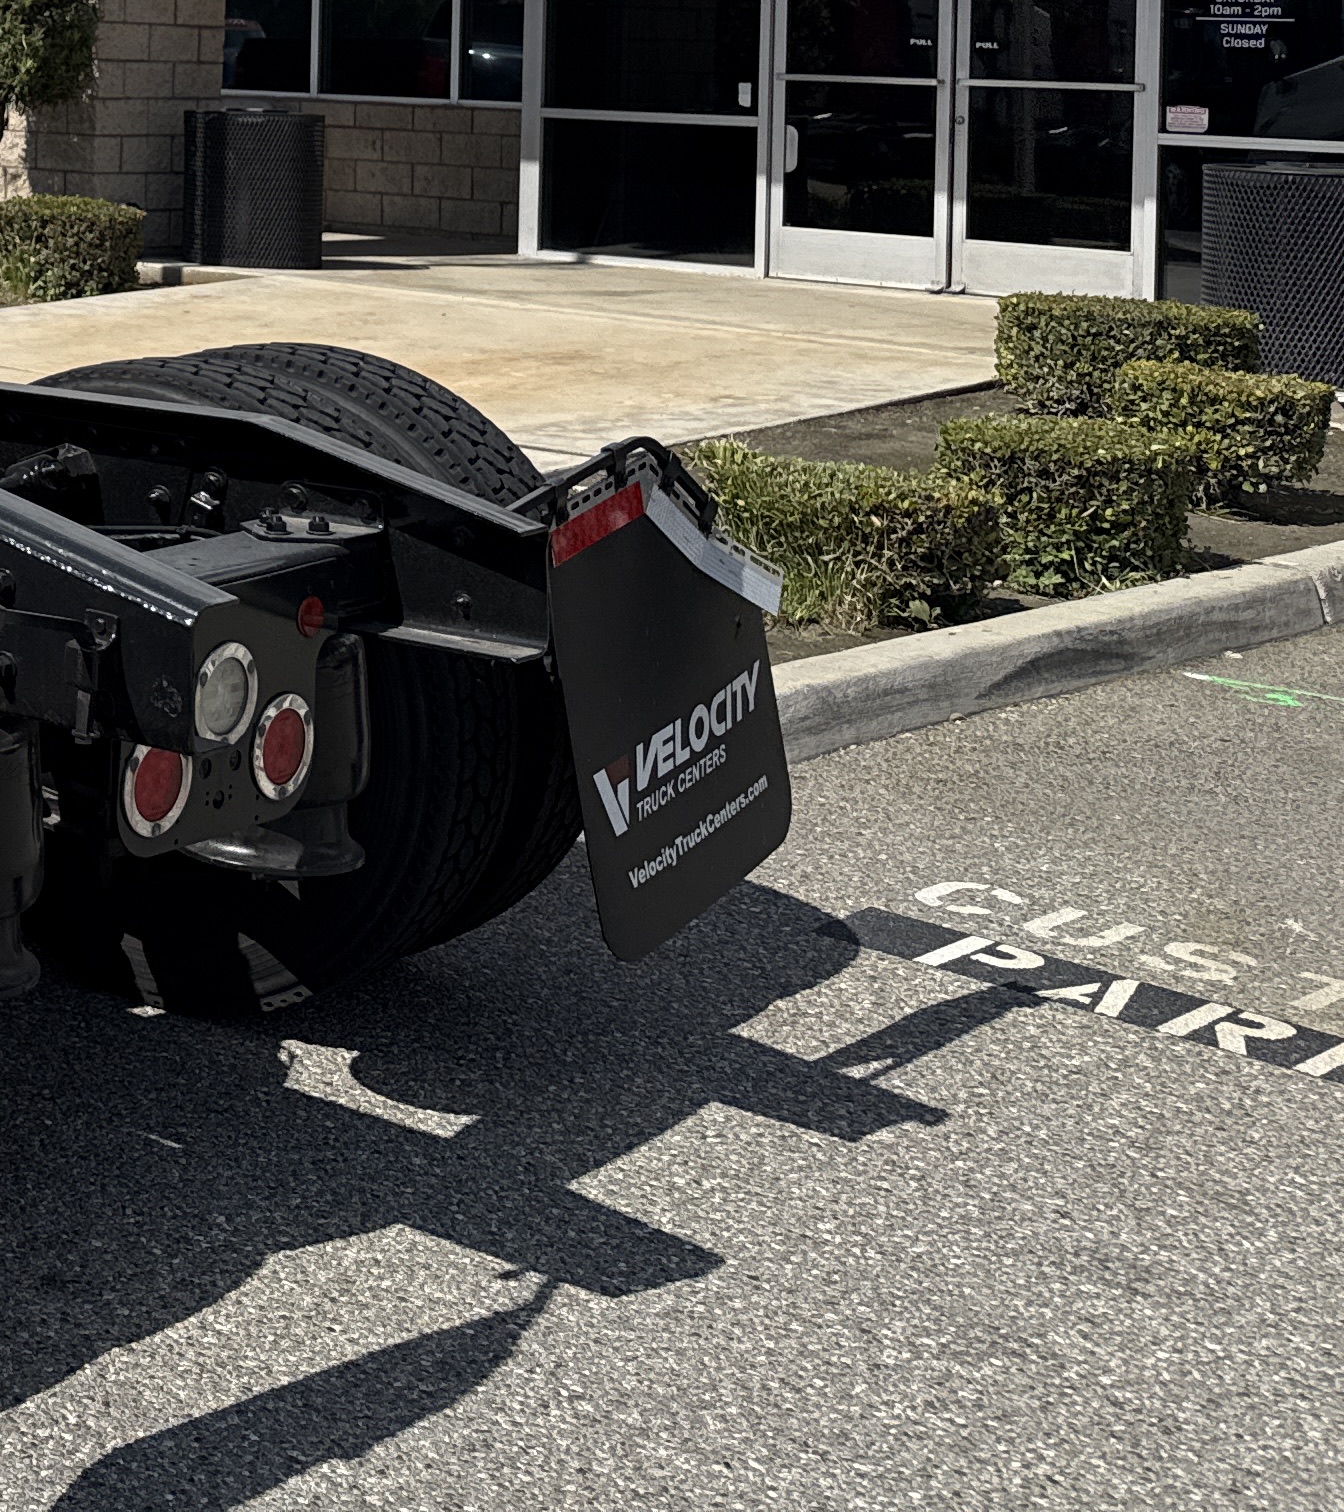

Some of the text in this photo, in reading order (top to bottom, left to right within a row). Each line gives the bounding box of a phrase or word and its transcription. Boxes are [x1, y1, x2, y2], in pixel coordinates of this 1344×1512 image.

[1210, 4, 1242, 15] 10am
[1254, 5, 1282, 17] 2pm
[1220, 24, 1268, 34] SUNDAY
[910, 38, 932, 46] PULL
[1223, 37, 1265, 48] Closed
[636, 659, 760, 792] VELOCITY
[636, 744, 727, 822] TRUCK CENTERS
[628, 774, 768, 888] VelocityTruckCenters.com
